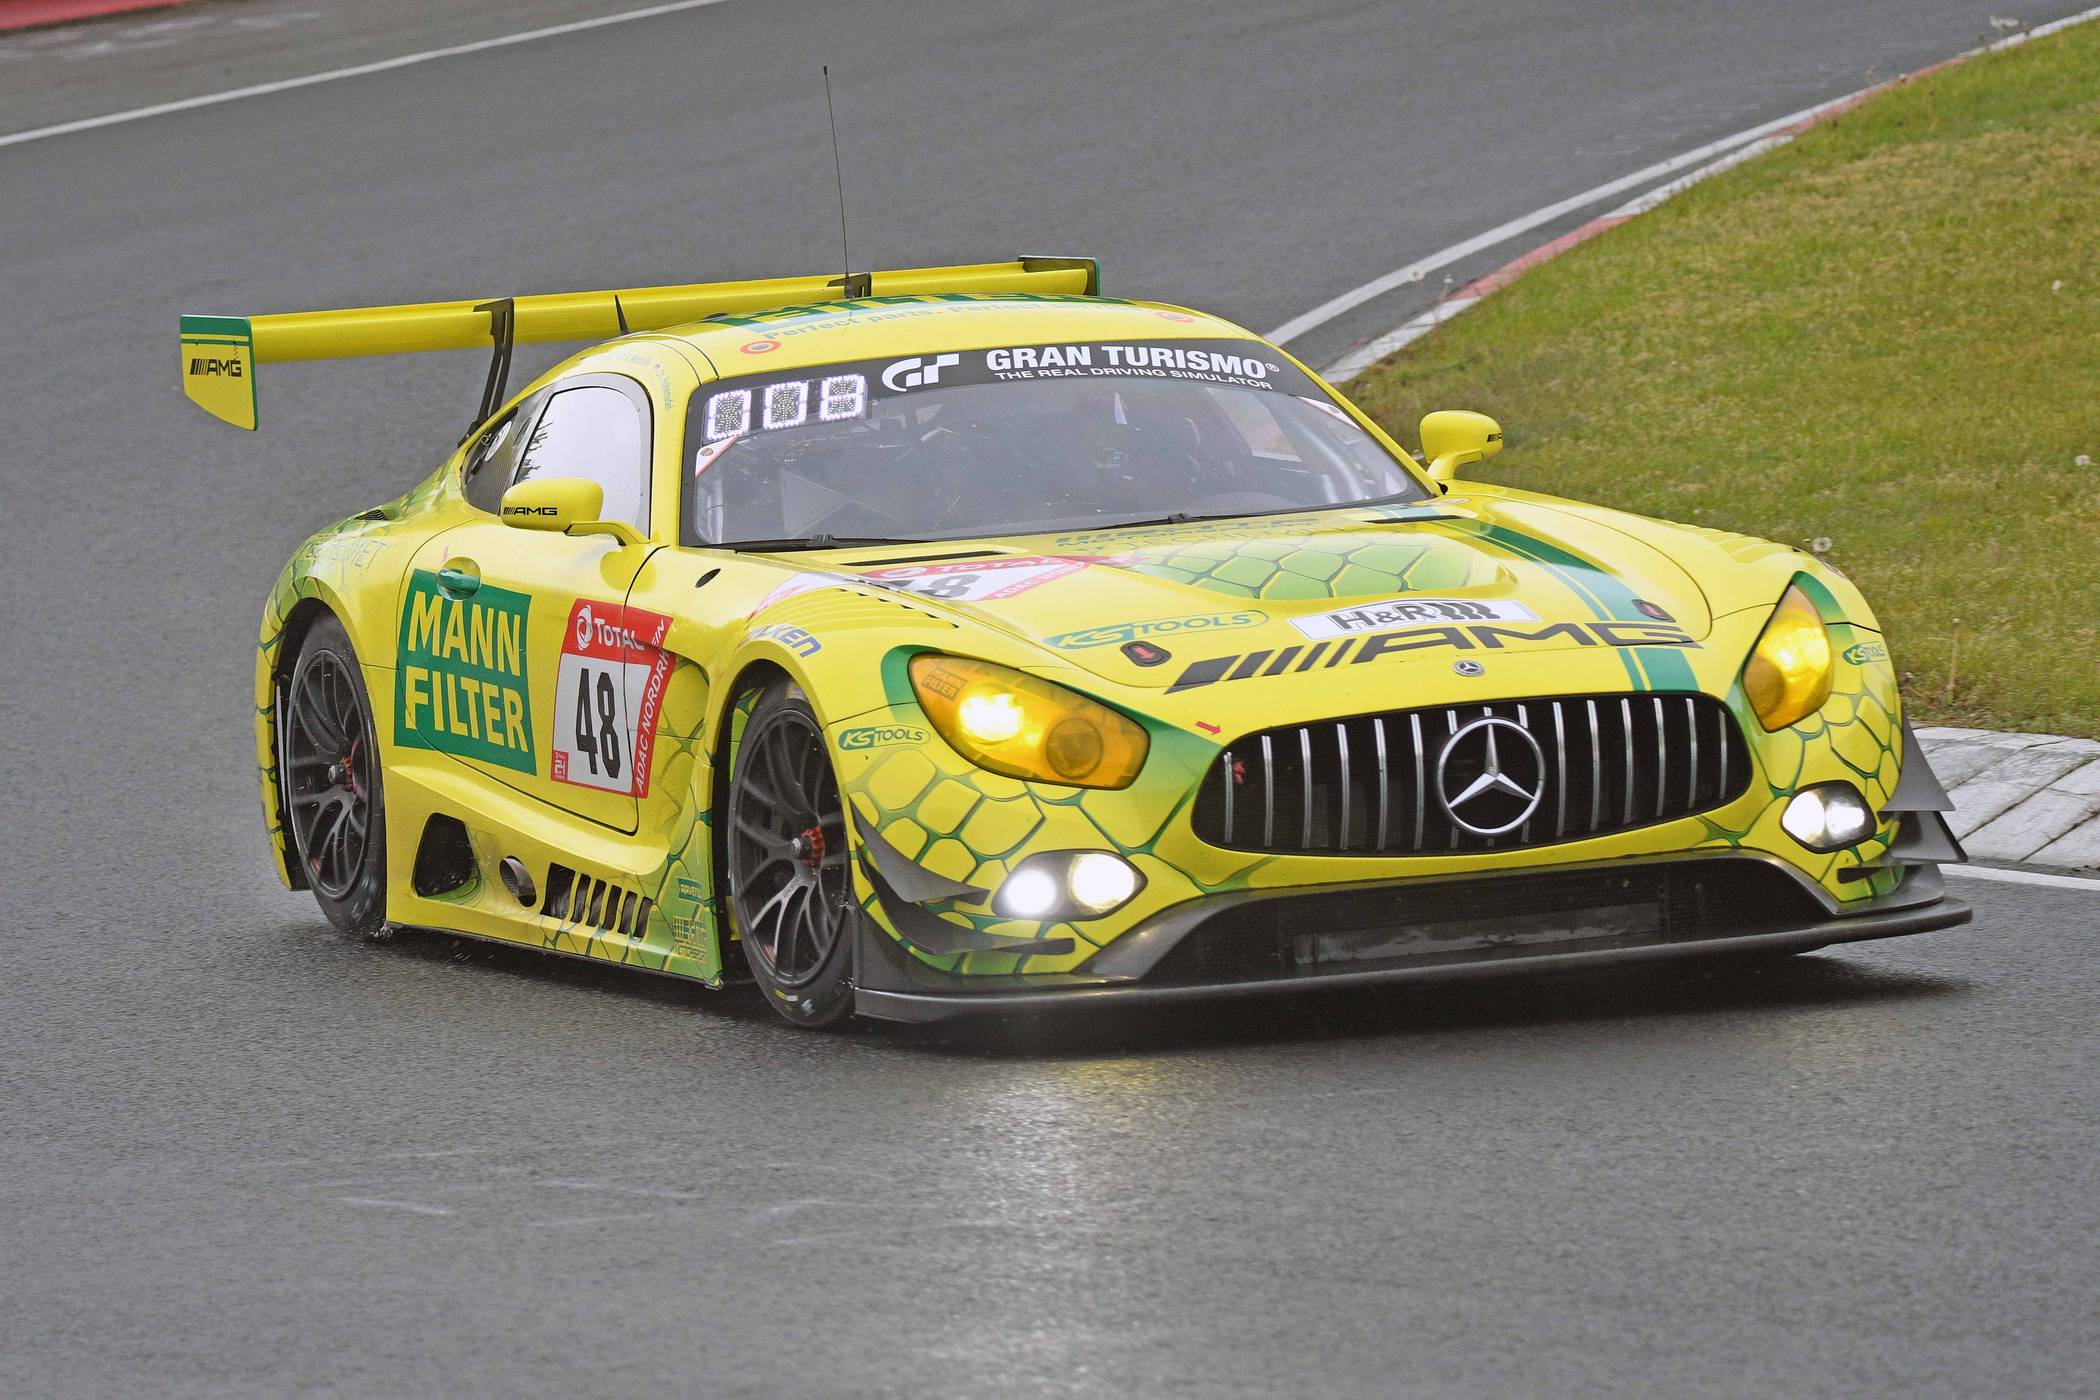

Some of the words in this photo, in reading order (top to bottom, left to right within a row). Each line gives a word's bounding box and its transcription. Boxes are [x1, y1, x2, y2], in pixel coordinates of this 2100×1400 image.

[762, 317, 861, 340] Perfect
[986, 345, 1092, 372] GRAN
[995, 371, 1035, 380] THE
[1040, 367, 1088, 378] REAL
[1091, 368, 1166, 378] DRIVING
[1174, 370, 1273, 390] SIMULATOR
[408, 590, 522, 677] MANN
[594, 617, 645, 652] TOTAL
[1133, 614, 1251, 635] TOOLS
[1350, 622, 1697, 665] AMG
[405, 665, 529, 753] FILTER
[576, 668, 621, 779] 48
[875, 729, 922, 742] TOOLS
[635, 736, 649, 794] ADAC
